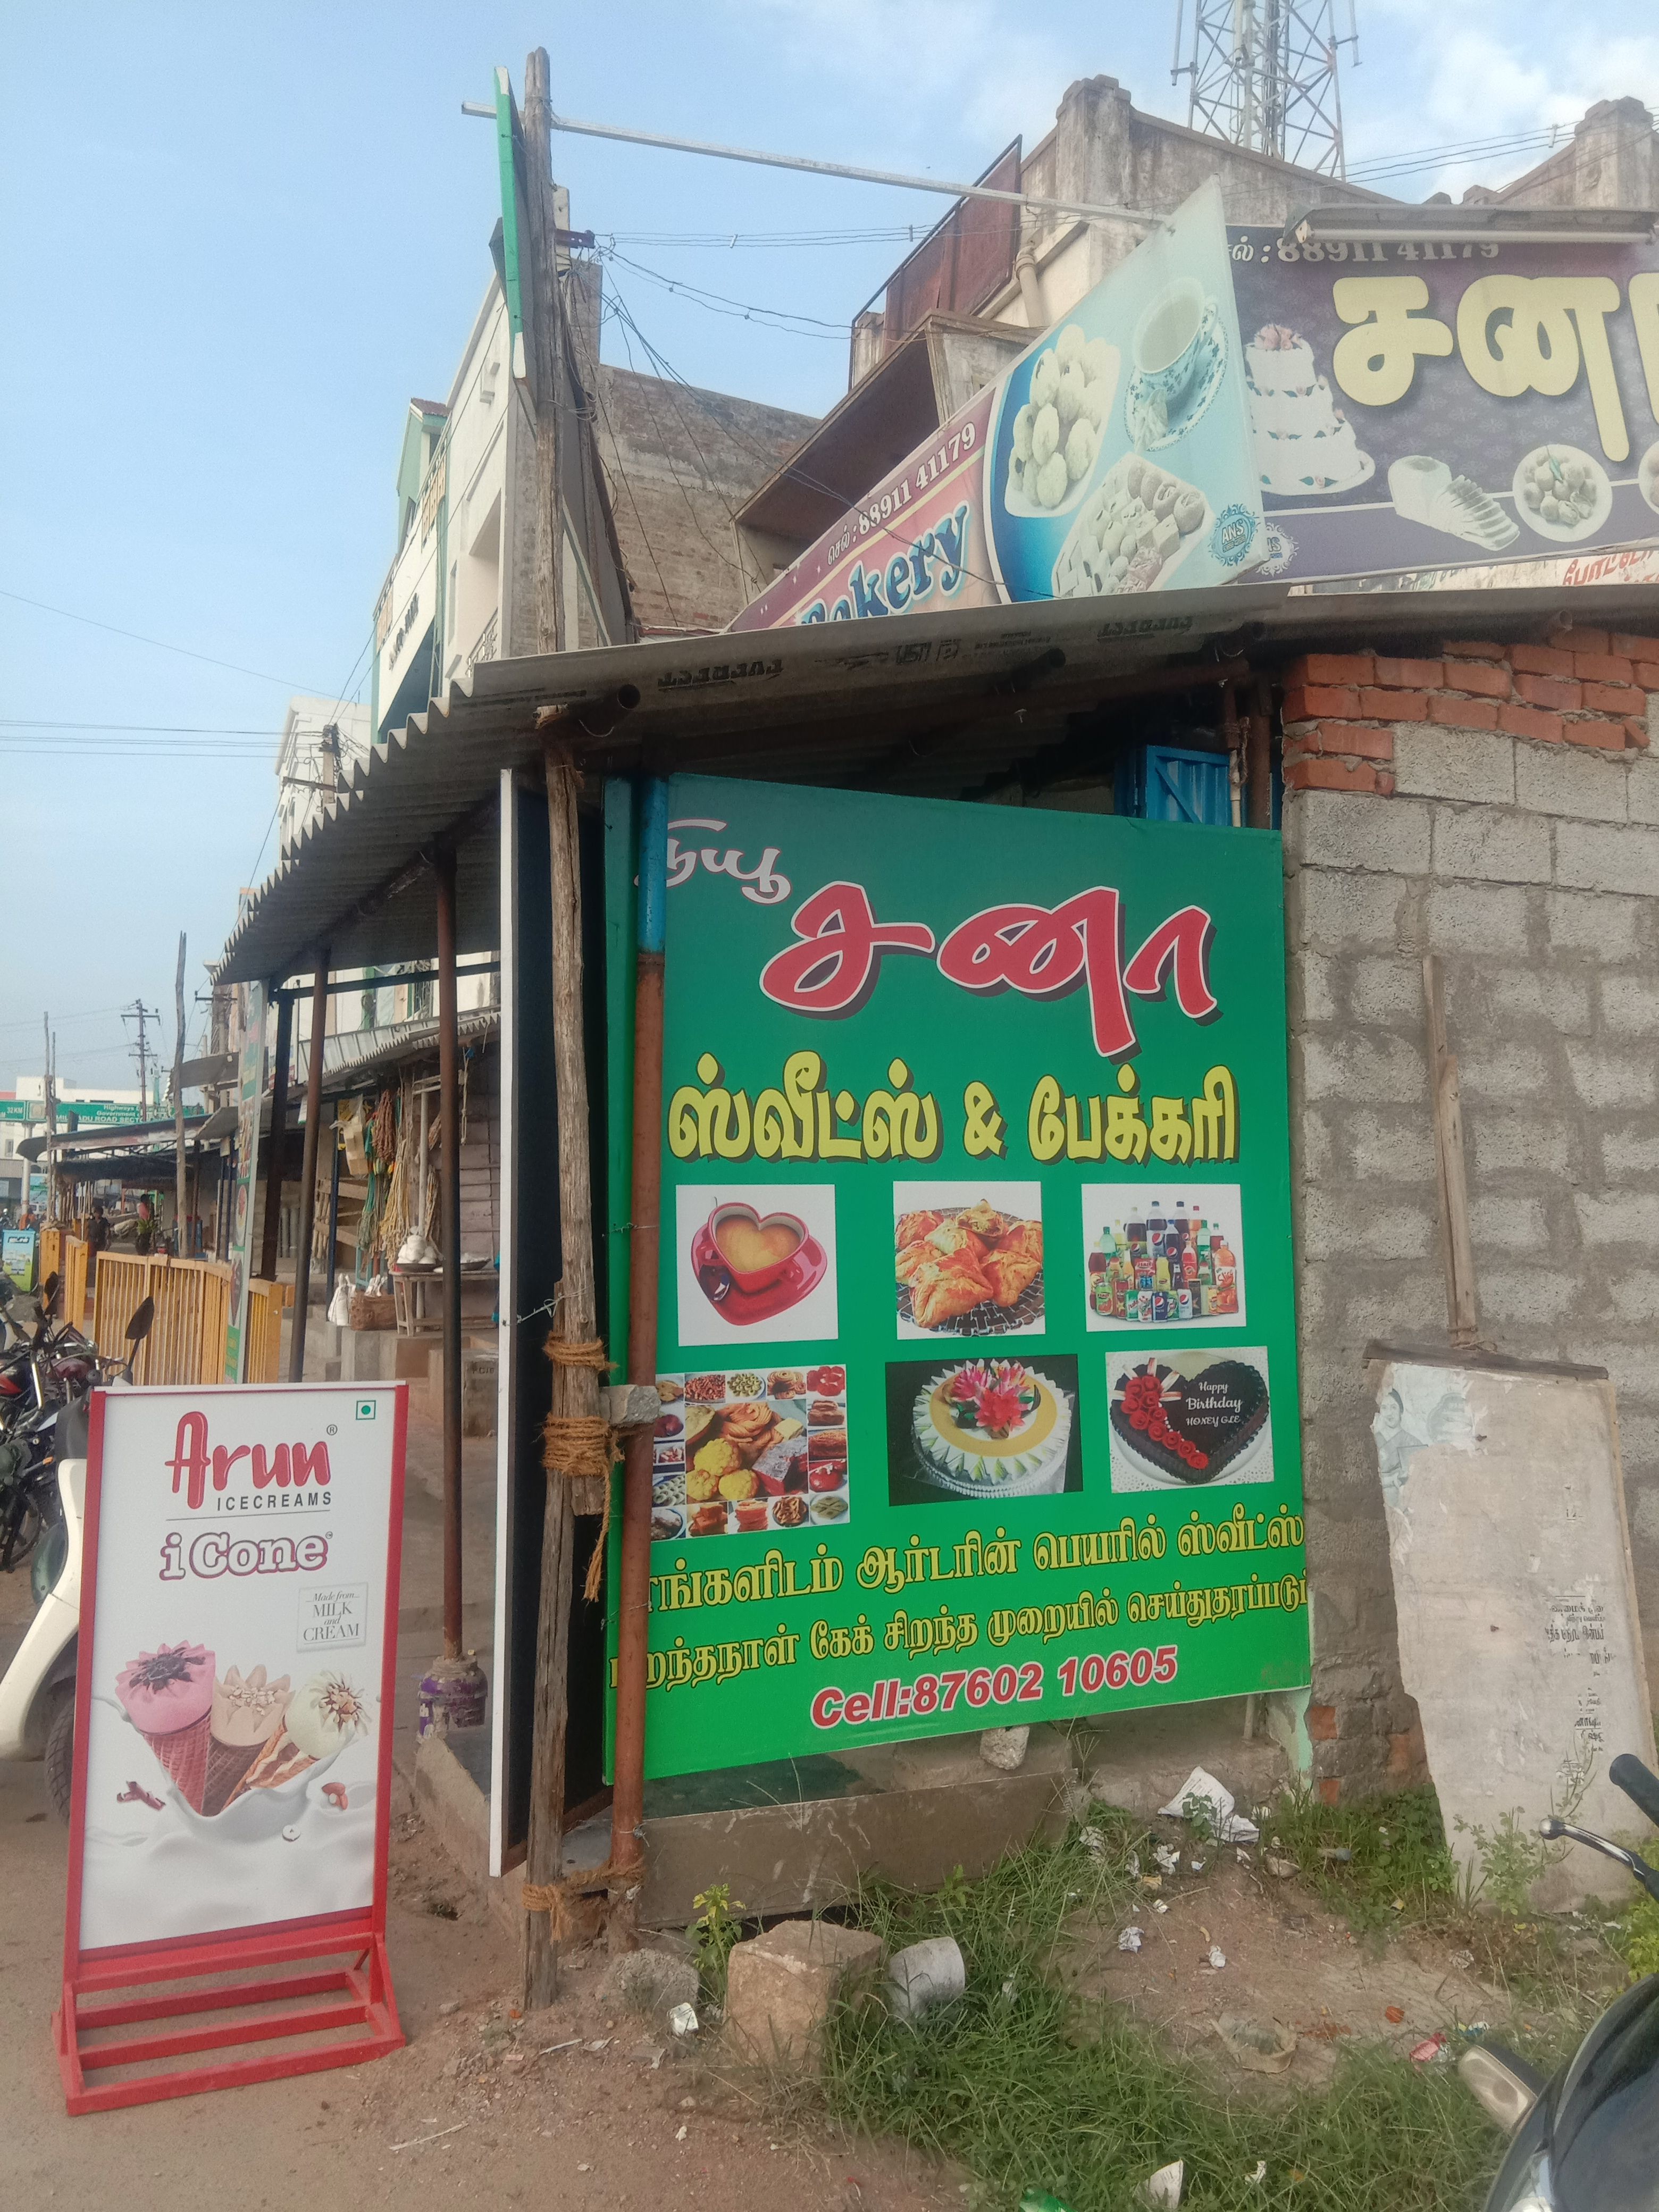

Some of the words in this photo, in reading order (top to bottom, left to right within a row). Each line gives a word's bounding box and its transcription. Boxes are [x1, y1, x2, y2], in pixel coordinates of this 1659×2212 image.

[859, 479, 912, 535] 88911
[915, 422, 976, 490] 41179
[1221, 518, 1245, 545] ANS
[760, 881, 1218, 1057] சனா
[668, 1050, 940, 1160] ஸ்வீட்ஸ்
[963, 1081, 1005, 1156] &
[1027, 1063, 1237, 1161] பேக்கரி
[1199, 1381, 1228, 1394] Happy
[1186, 1396, 1242, 1413] Birthday
[164, 1411, 331, 1509] Arun
[217, 1492, 331, 1511] ICECREAMS
[648, 1543, 843, 1613] ங்களிடம்
[856, 1524, 1021, 1594] ஆர்டரின்
[1033, 1513, 1167, 1571] பெயரில்
[1177, 1502, 1304, 1557] ஸ்வீட்ஸ்
[313, 1591, 334, 1602] Made
[335, 1590, 354, 1602] from
[313, 1602, 353, 1618] MILK
[324, 1615, 341, 1625] and
[809, 1613, 874, 1660] கேக்
[884, 1604, 978, 1660] சிறந்த
[986, 1587, 1119, 1644] முறையில்
[303, 1623, 359, 1641] CREAM
[810, 1662, 1044, 1730] Cell:87602
[1058, 1645, 1178, 1696] 10605
